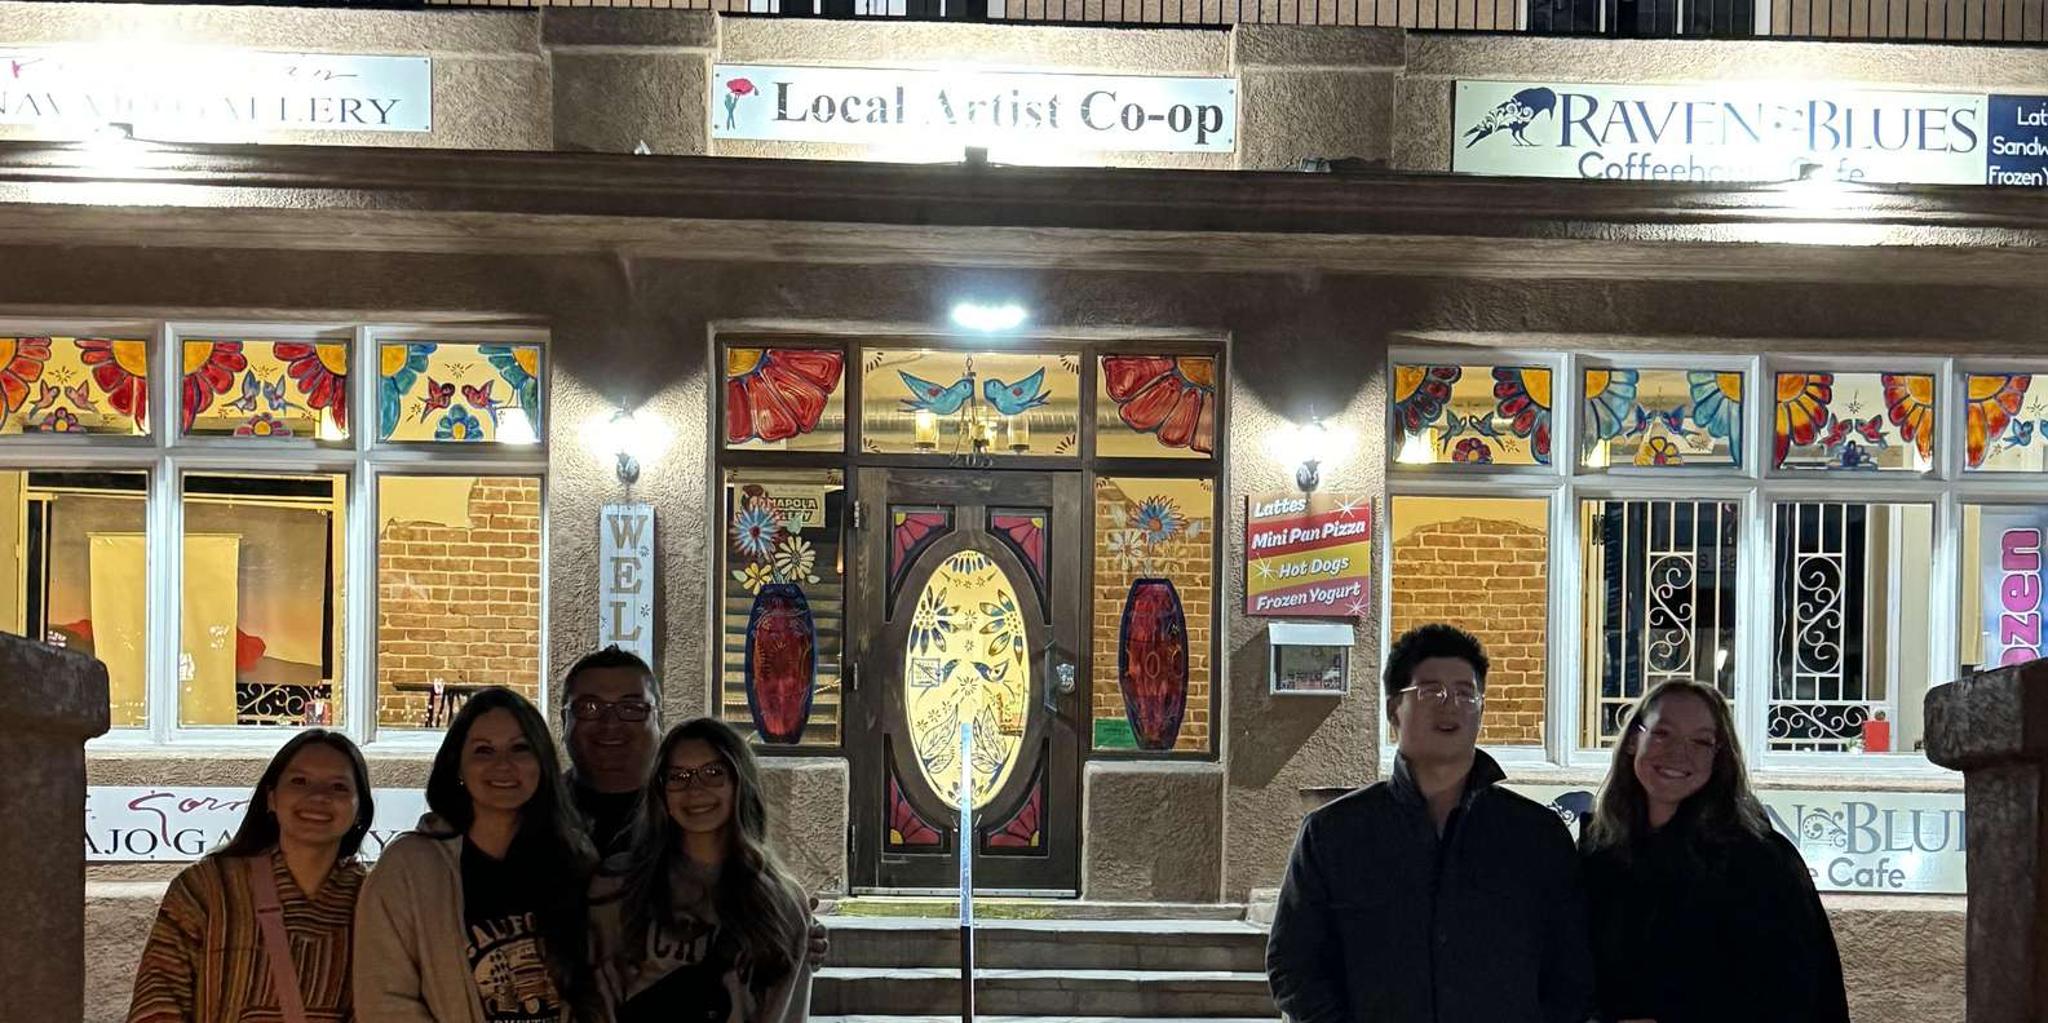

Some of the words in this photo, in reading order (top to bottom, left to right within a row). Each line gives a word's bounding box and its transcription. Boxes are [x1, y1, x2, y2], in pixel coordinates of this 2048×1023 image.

[772, 81, 904, 125] Local
[924, 88, 1060, 129] Artist
[1081, 90, 1223, 145] Co-op
[1555, 92, 1764, 149] RAVEN
[1808, 98, 1978, 153] BLUES
[1988, 165, 2042, 186] Frozen
[1253, 498, 1307, 518] Lattes
[1251, 528, 1289, 549] Mini
[1289, 526, 1320, 544] Pan
[1321, 520, 1366, 539] Pizza
[1279, 560, 1308, 579] Hot
[1311, 556, 1350, 576] Dogs
[1256, 591, 1308, 611] Frozen
[1309, 581, 1361, 605] Yogurt
[1828, 856, 1906, 888] Cafe
